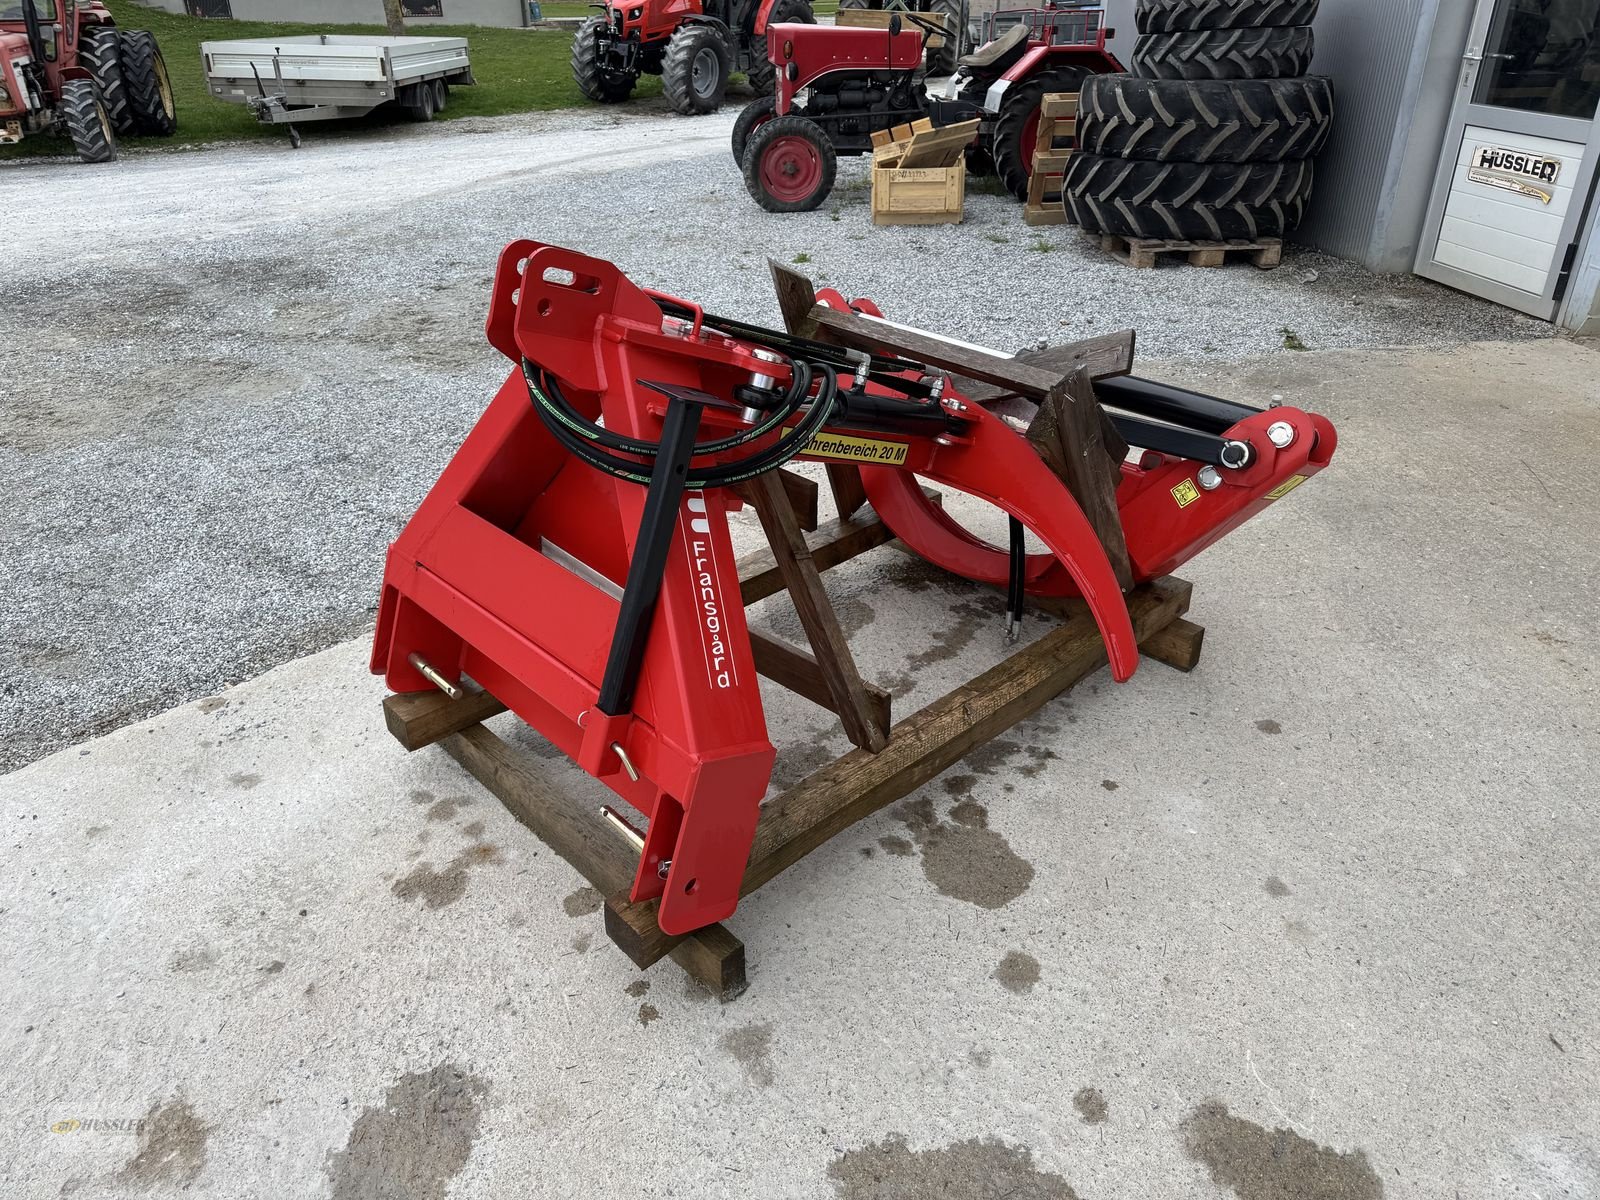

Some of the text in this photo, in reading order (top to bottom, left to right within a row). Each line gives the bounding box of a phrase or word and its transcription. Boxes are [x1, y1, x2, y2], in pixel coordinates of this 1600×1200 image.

[803, 436, 906, 460] ahrenbereich 20 M
